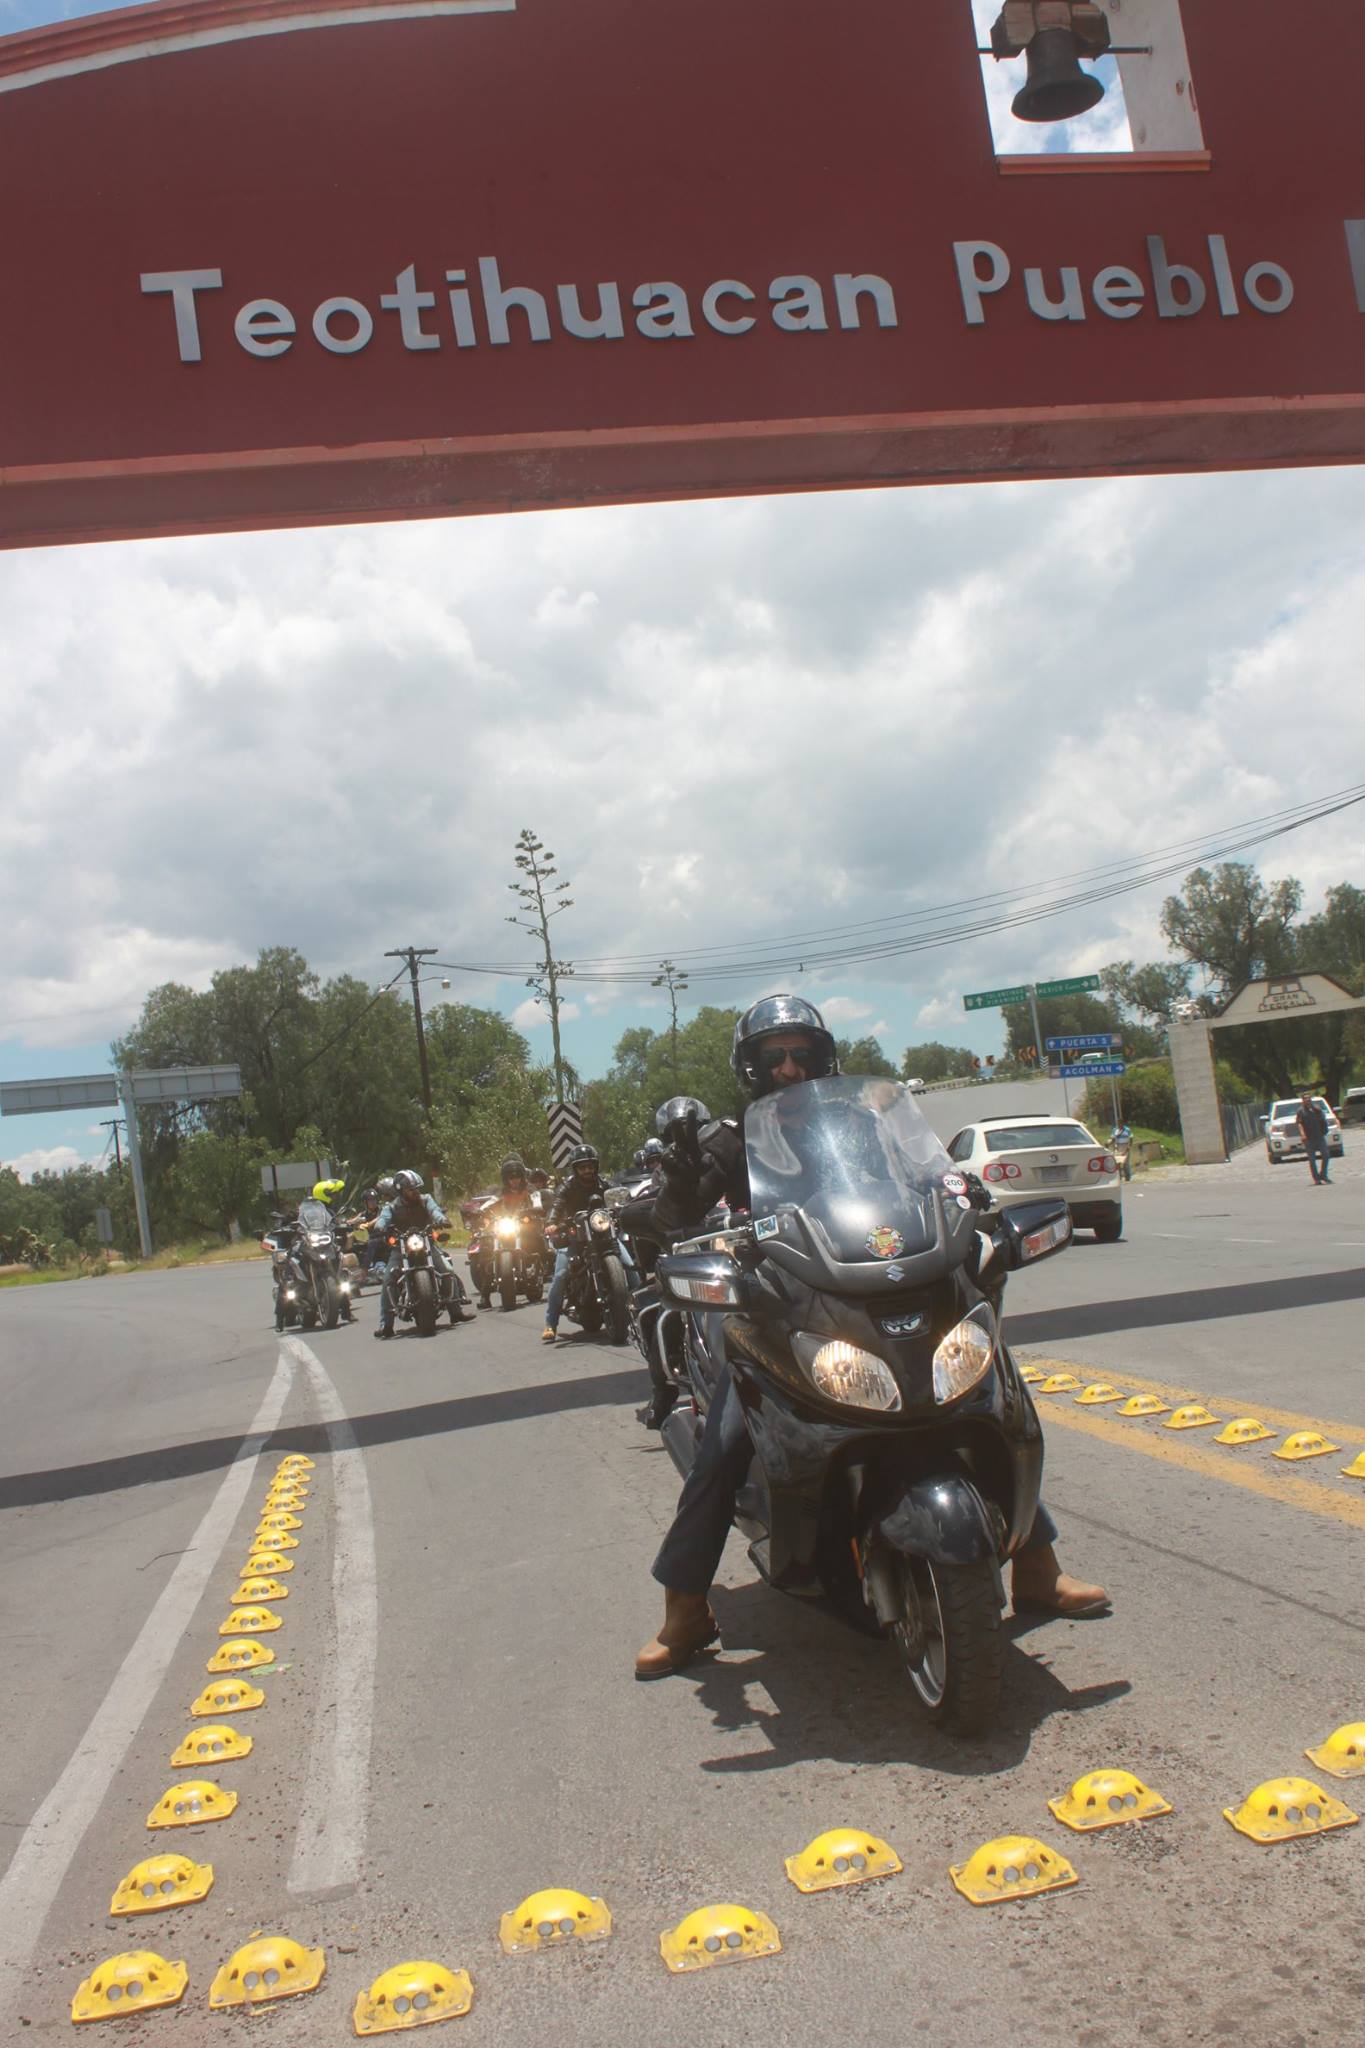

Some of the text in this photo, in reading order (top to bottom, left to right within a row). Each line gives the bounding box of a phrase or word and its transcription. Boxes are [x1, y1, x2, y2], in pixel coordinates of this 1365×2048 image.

[139, 255, 899, 363] Teotihuacan
[952, 234, 1294, 325] Pueblo
[1060, 1038, 1097, 1047] PUERTA
[1064, 1066, 1112, 1076] ACOLMAN
